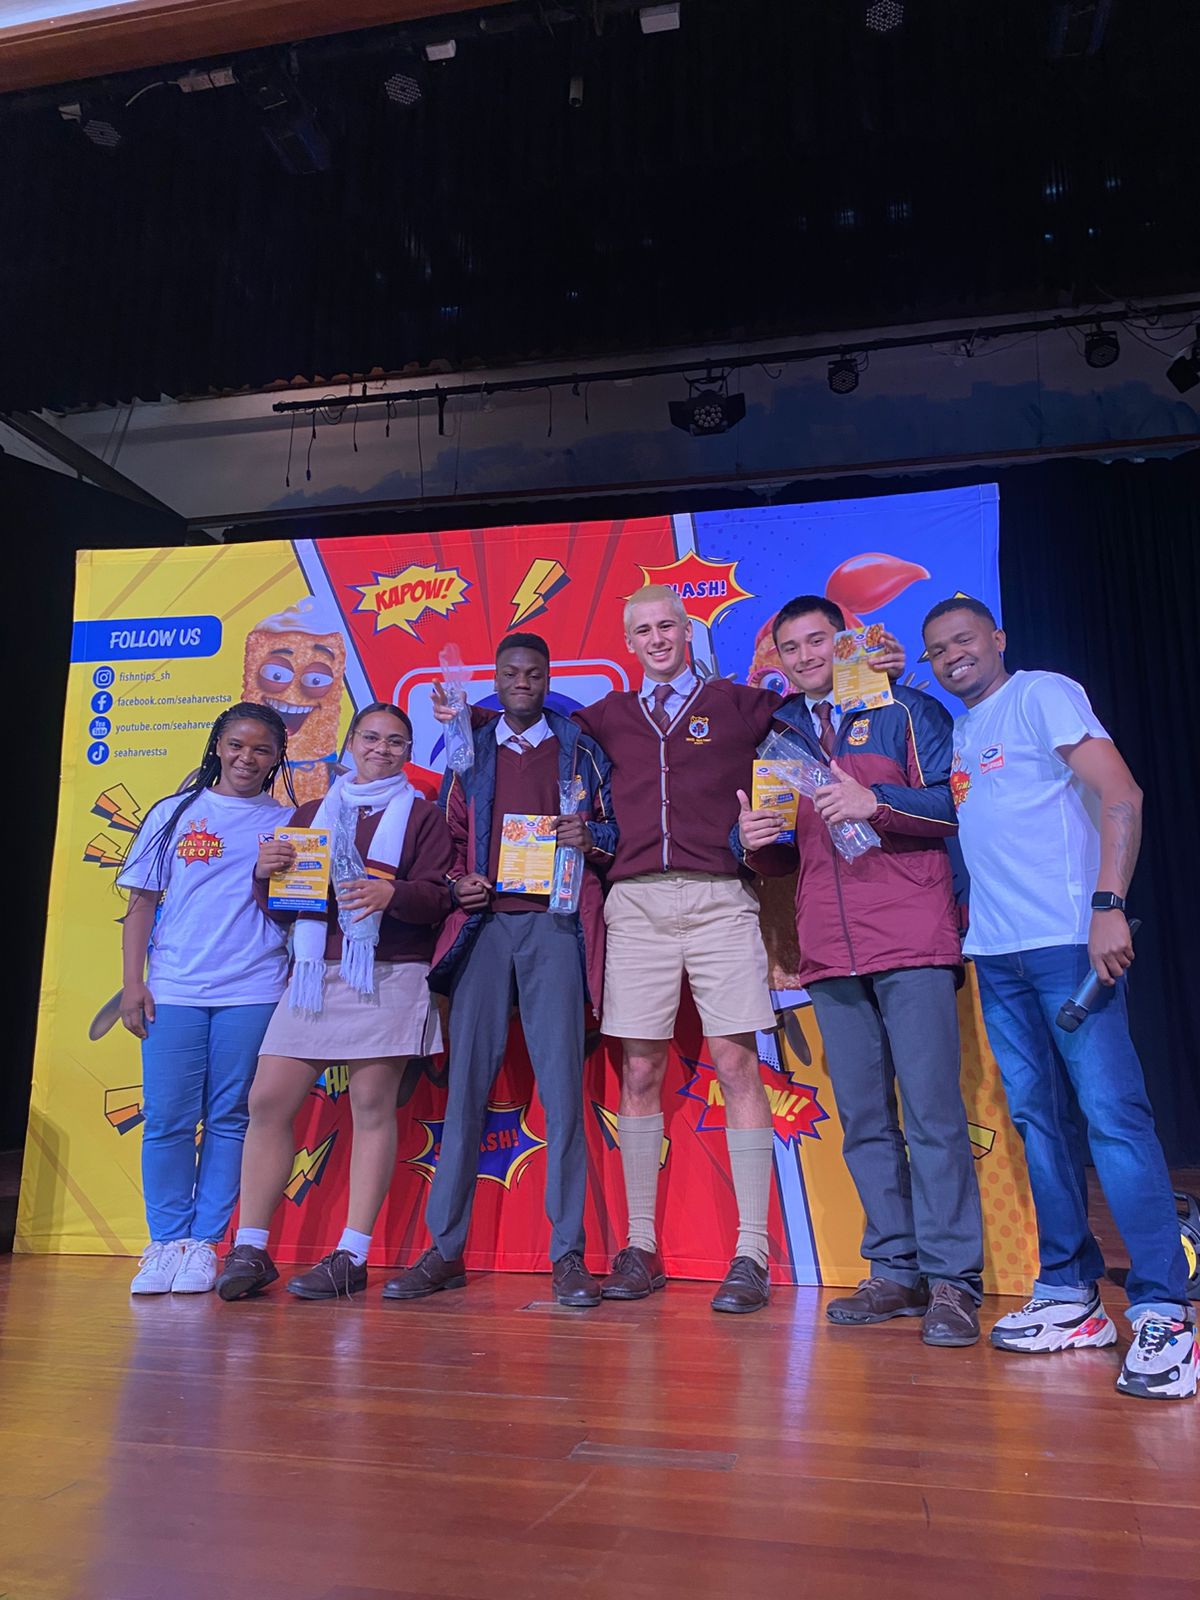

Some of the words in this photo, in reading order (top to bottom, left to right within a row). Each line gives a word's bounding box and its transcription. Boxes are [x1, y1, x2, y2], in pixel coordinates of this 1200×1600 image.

[375, 577, 456, 612] KAPOW!
[664, 580, 727, 599] LASH!
[109, 628, 177, 649] FOLLOW
[179, 627, 201, 646] US
[119, 671, 171, 683] fishntips_sh
[117, 693, 232, 707] facebook.com/seaharvestsa
[115, 719, 215, 734] youtube.com/seaharves
[113, 747, 168, 758] seaharvestsa
